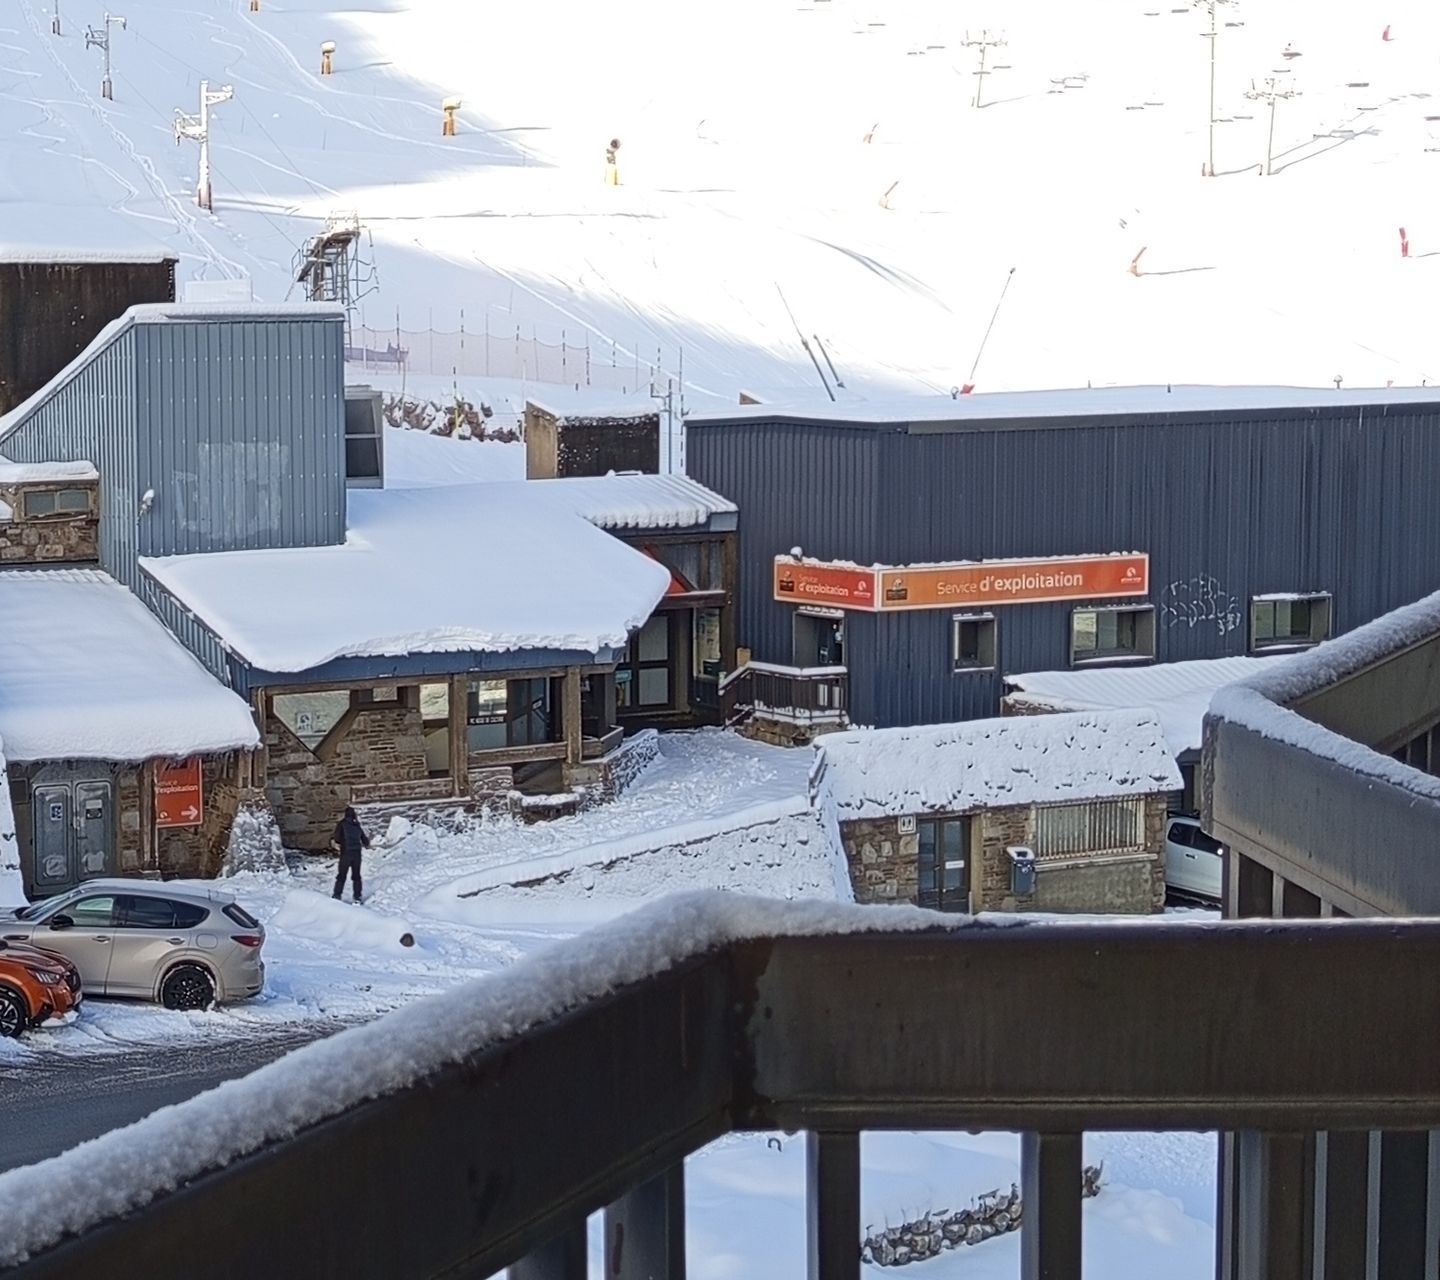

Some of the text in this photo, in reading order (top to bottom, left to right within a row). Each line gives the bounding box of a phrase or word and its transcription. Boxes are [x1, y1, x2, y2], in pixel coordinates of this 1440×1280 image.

[798, 581, 849, 597] d'exploitation
[936, 571, 1084, 596] Service d'exploitation
